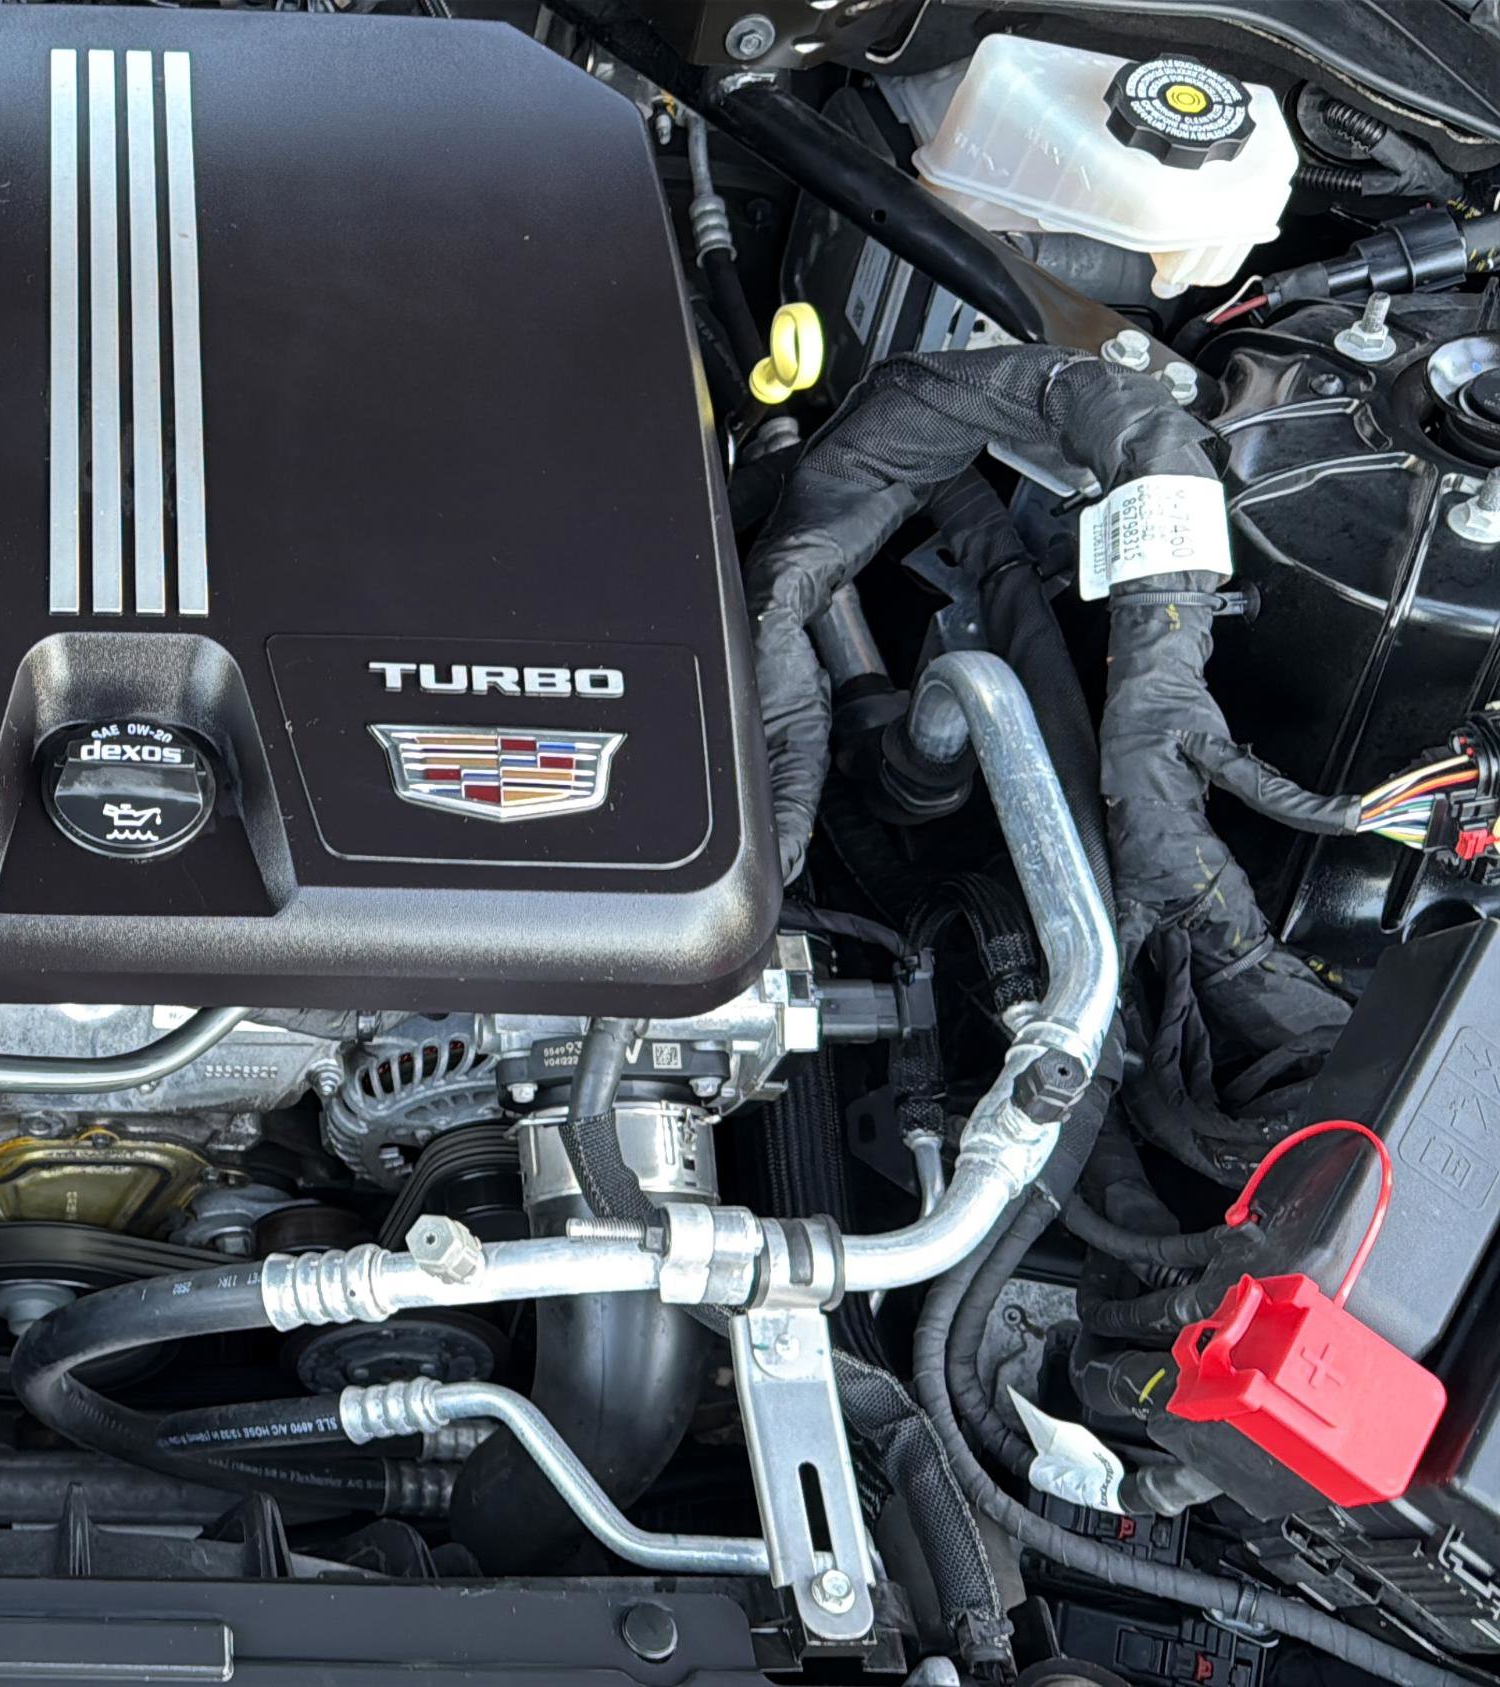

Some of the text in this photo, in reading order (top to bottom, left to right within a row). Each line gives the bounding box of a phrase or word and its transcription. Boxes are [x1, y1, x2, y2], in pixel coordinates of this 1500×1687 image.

[1122, 497, 1142, 561] 86798315
[368, 661, 625, 698] TURBO
[91, 723, 174, 743] SAE 0W-20
[80, 740, 182, 763] dexos
